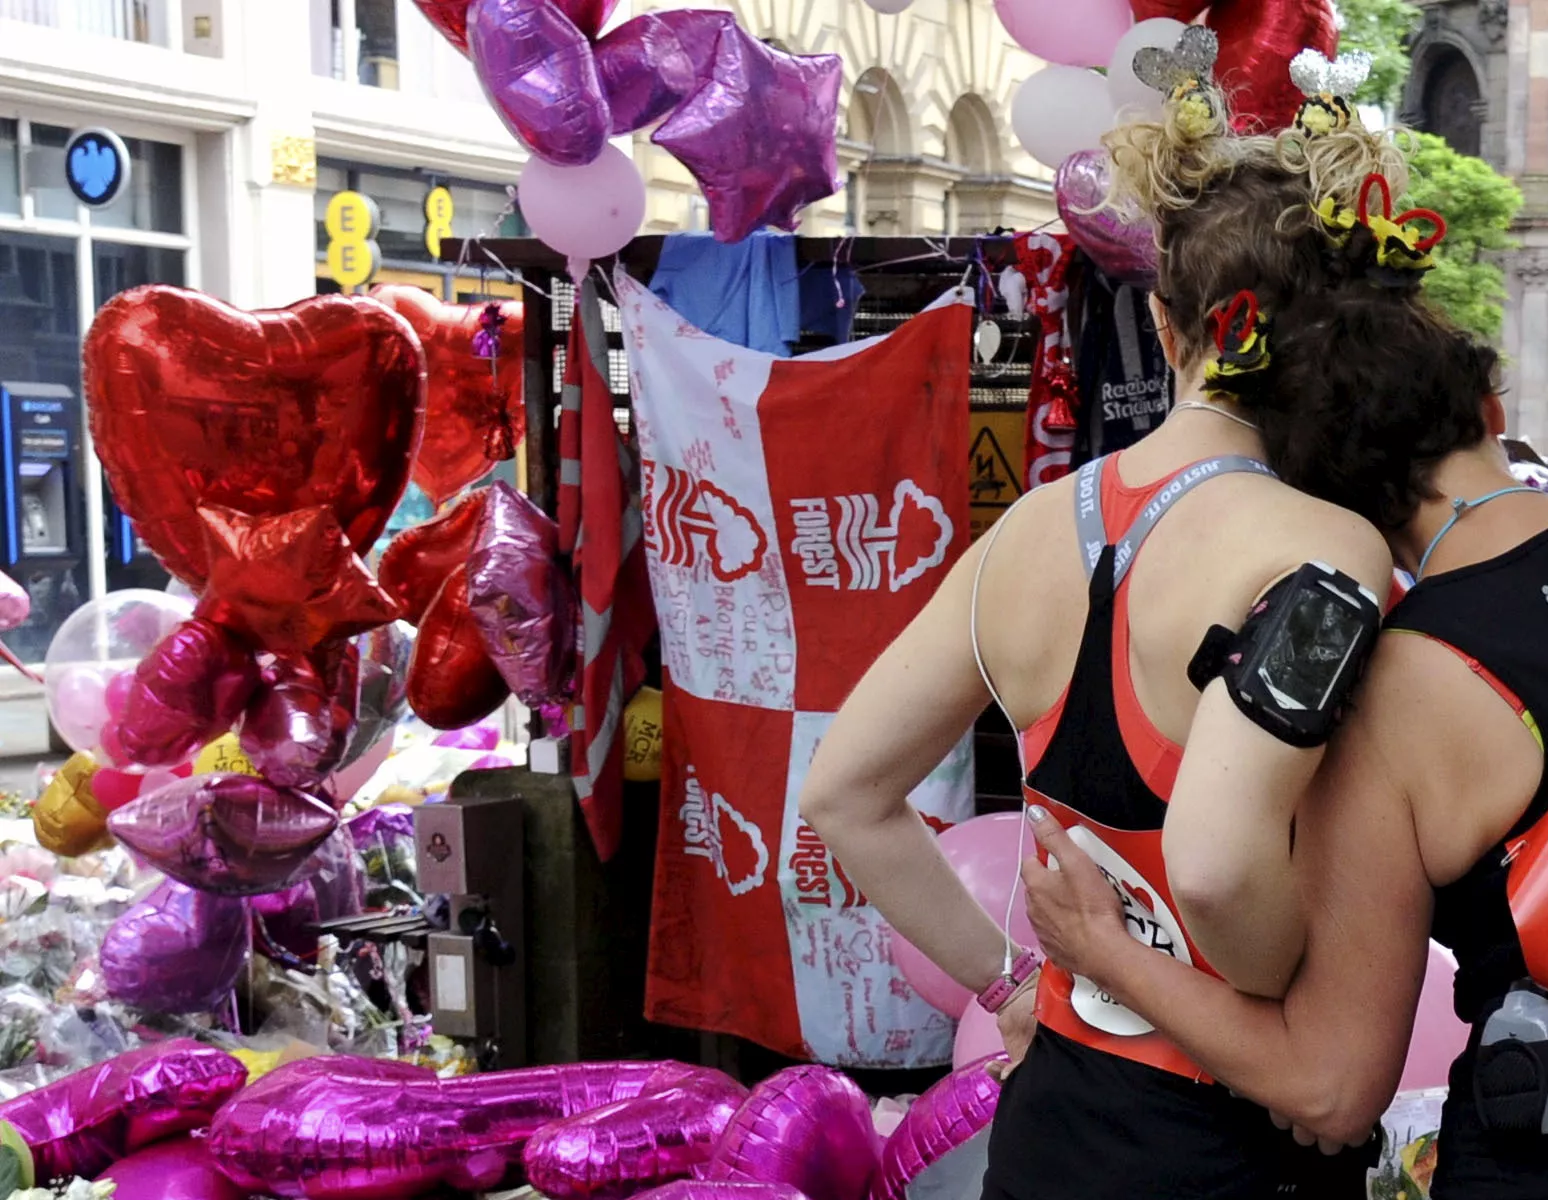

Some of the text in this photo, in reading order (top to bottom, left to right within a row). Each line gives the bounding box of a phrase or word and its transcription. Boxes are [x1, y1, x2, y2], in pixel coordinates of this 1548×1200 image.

[1103, 397, 1166, 422] Stadiu
[1184, 459, 1222, 485] JUST
[1160, 484, 1182, 504] DO
[1086, 540, 1102, 569] JUS
